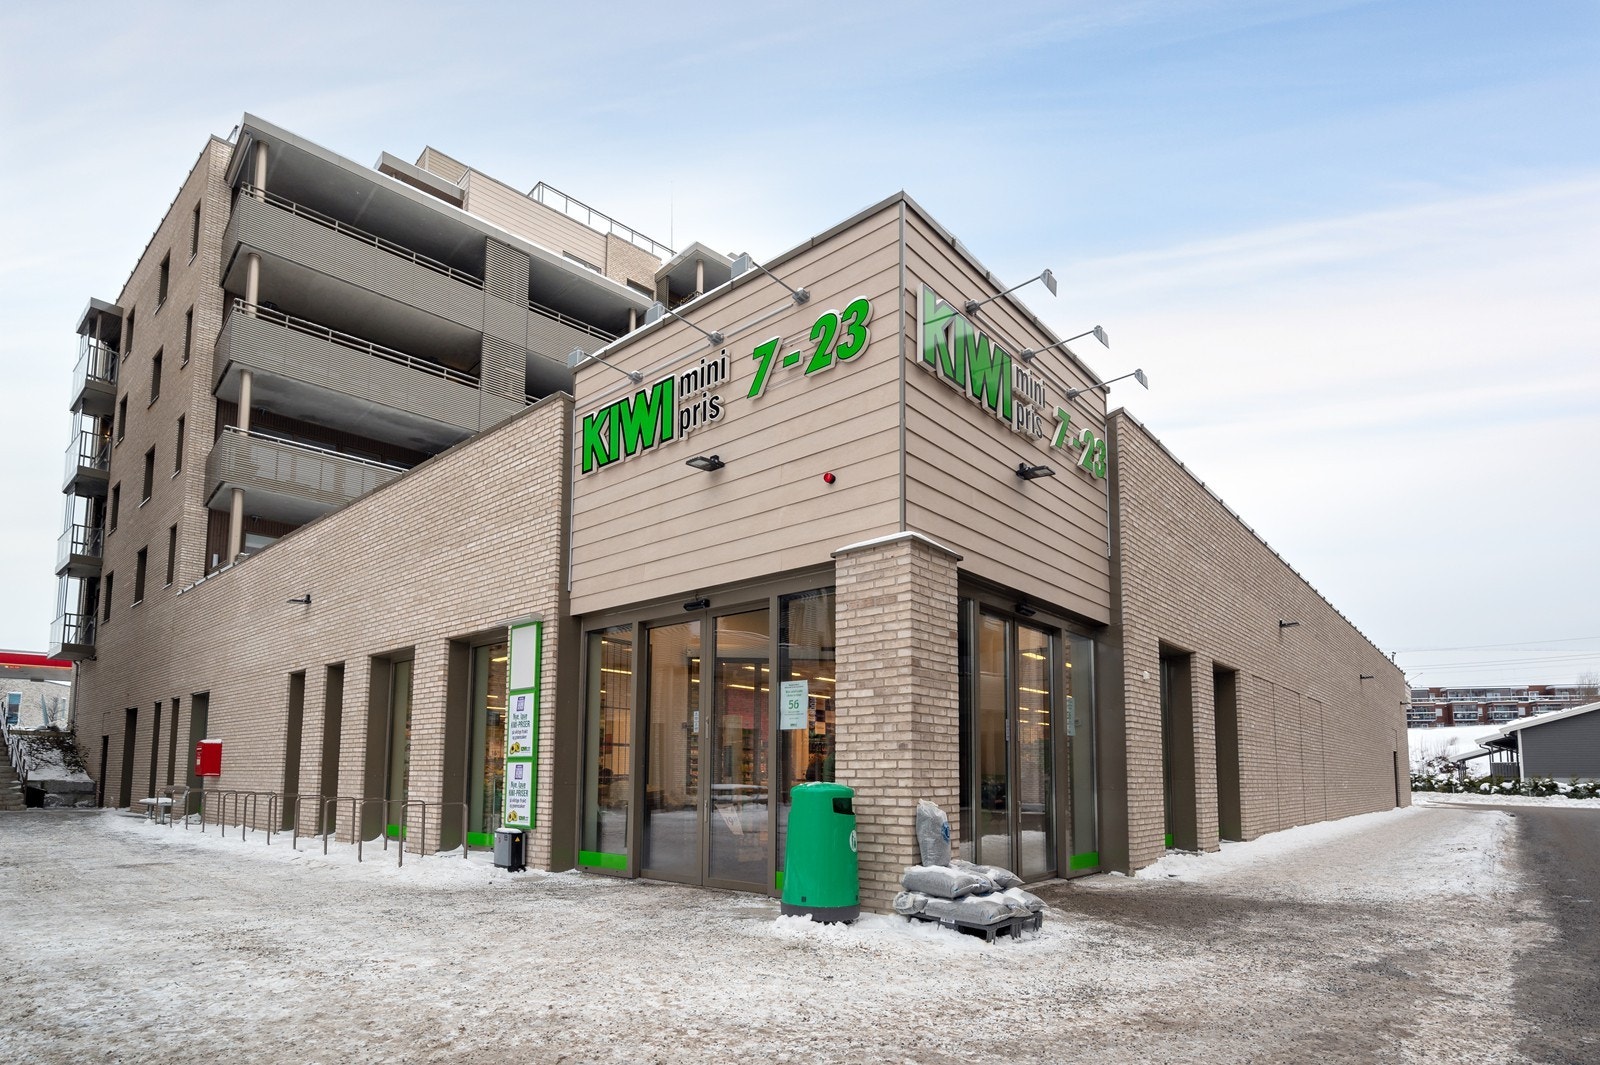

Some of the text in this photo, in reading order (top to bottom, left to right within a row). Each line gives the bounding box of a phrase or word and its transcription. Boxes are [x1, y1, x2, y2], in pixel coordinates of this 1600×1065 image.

[679, 348, 727, 398] mini
[921, 283, 1013, 424] KIWI
[1015, 366, 1046, 408] mini
[582, 375, 676, 475] KIWI
[679, 394, 721, 438] pris
[1016, 400, 1043, 439] pris
[788, 699, 799, 710] 56
